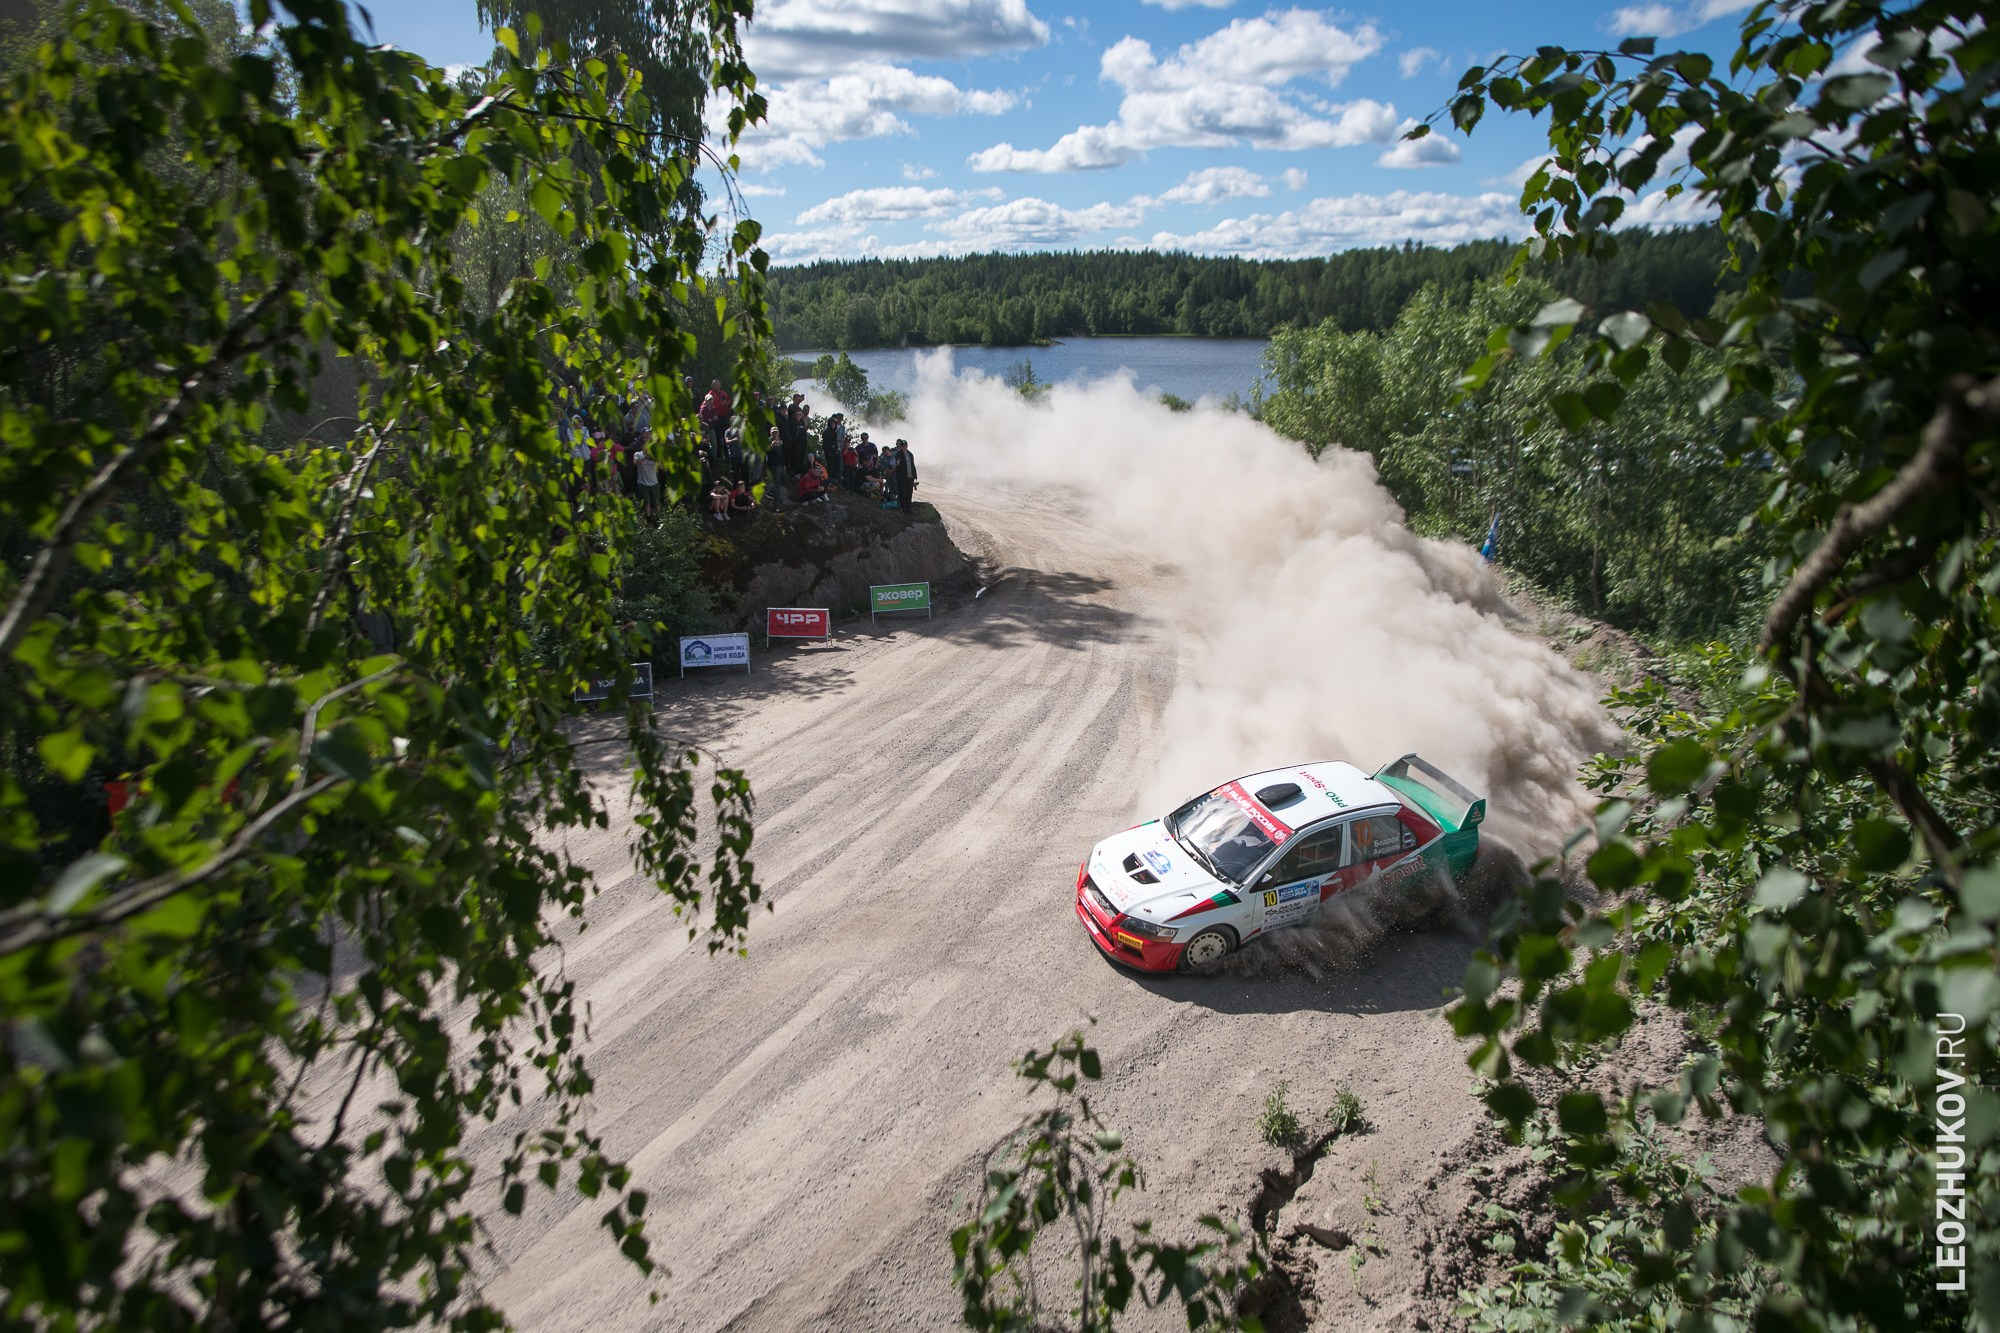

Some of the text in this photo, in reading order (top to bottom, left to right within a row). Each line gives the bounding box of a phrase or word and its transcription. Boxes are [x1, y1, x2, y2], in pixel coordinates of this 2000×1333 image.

[877, 589, 923, 601] эковер
[775, 613, 820, 624] ЧРР
[729, 651, 746, 659] ВОДА
[596, 676, 645, 688] YOKMA
[1228, 790, 1252, 809] РАЛЛИ
[1249, 807, 1277, 833] РОССИИ
[1354, 820, 1373, 848] 10
[1264, 891, 1277, 907] 10
